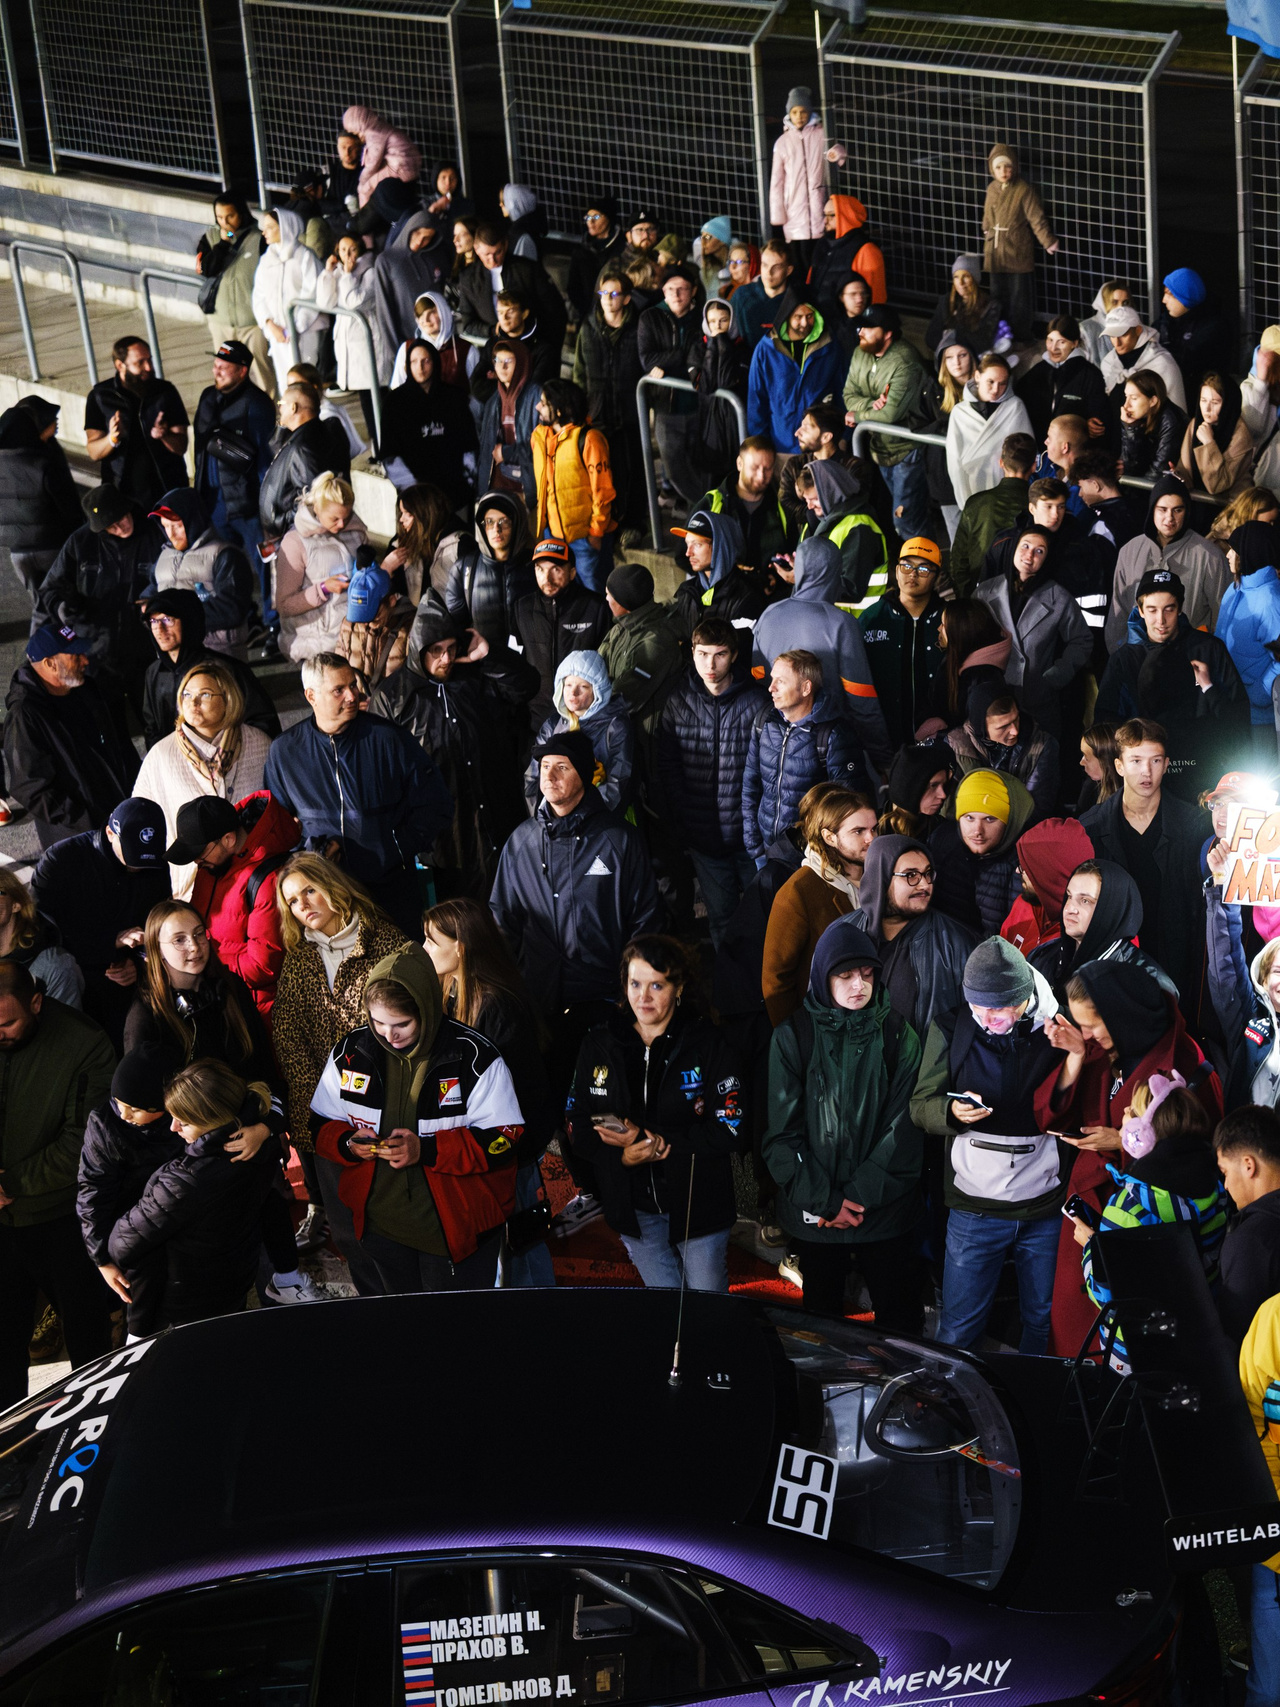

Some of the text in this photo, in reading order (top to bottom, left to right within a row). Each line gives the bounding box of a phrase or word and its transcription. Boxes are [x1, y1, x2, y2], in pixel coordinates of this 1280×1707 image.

[1168, 759, 1197, 767] ARTING
[35, 1338, 157, 1431] 55
[772, 1448, 834, 1535] 55
[430, 1610, 546, 1642] МАЗЕПИН Н.
[431, 1635, 530, 1664] ПРАХОВ В.
[434, 1674, 577, 1707] ГОМЕЛЬКОВ Д.
[844, 1658, 1012, 1702] KAMENSKIY
